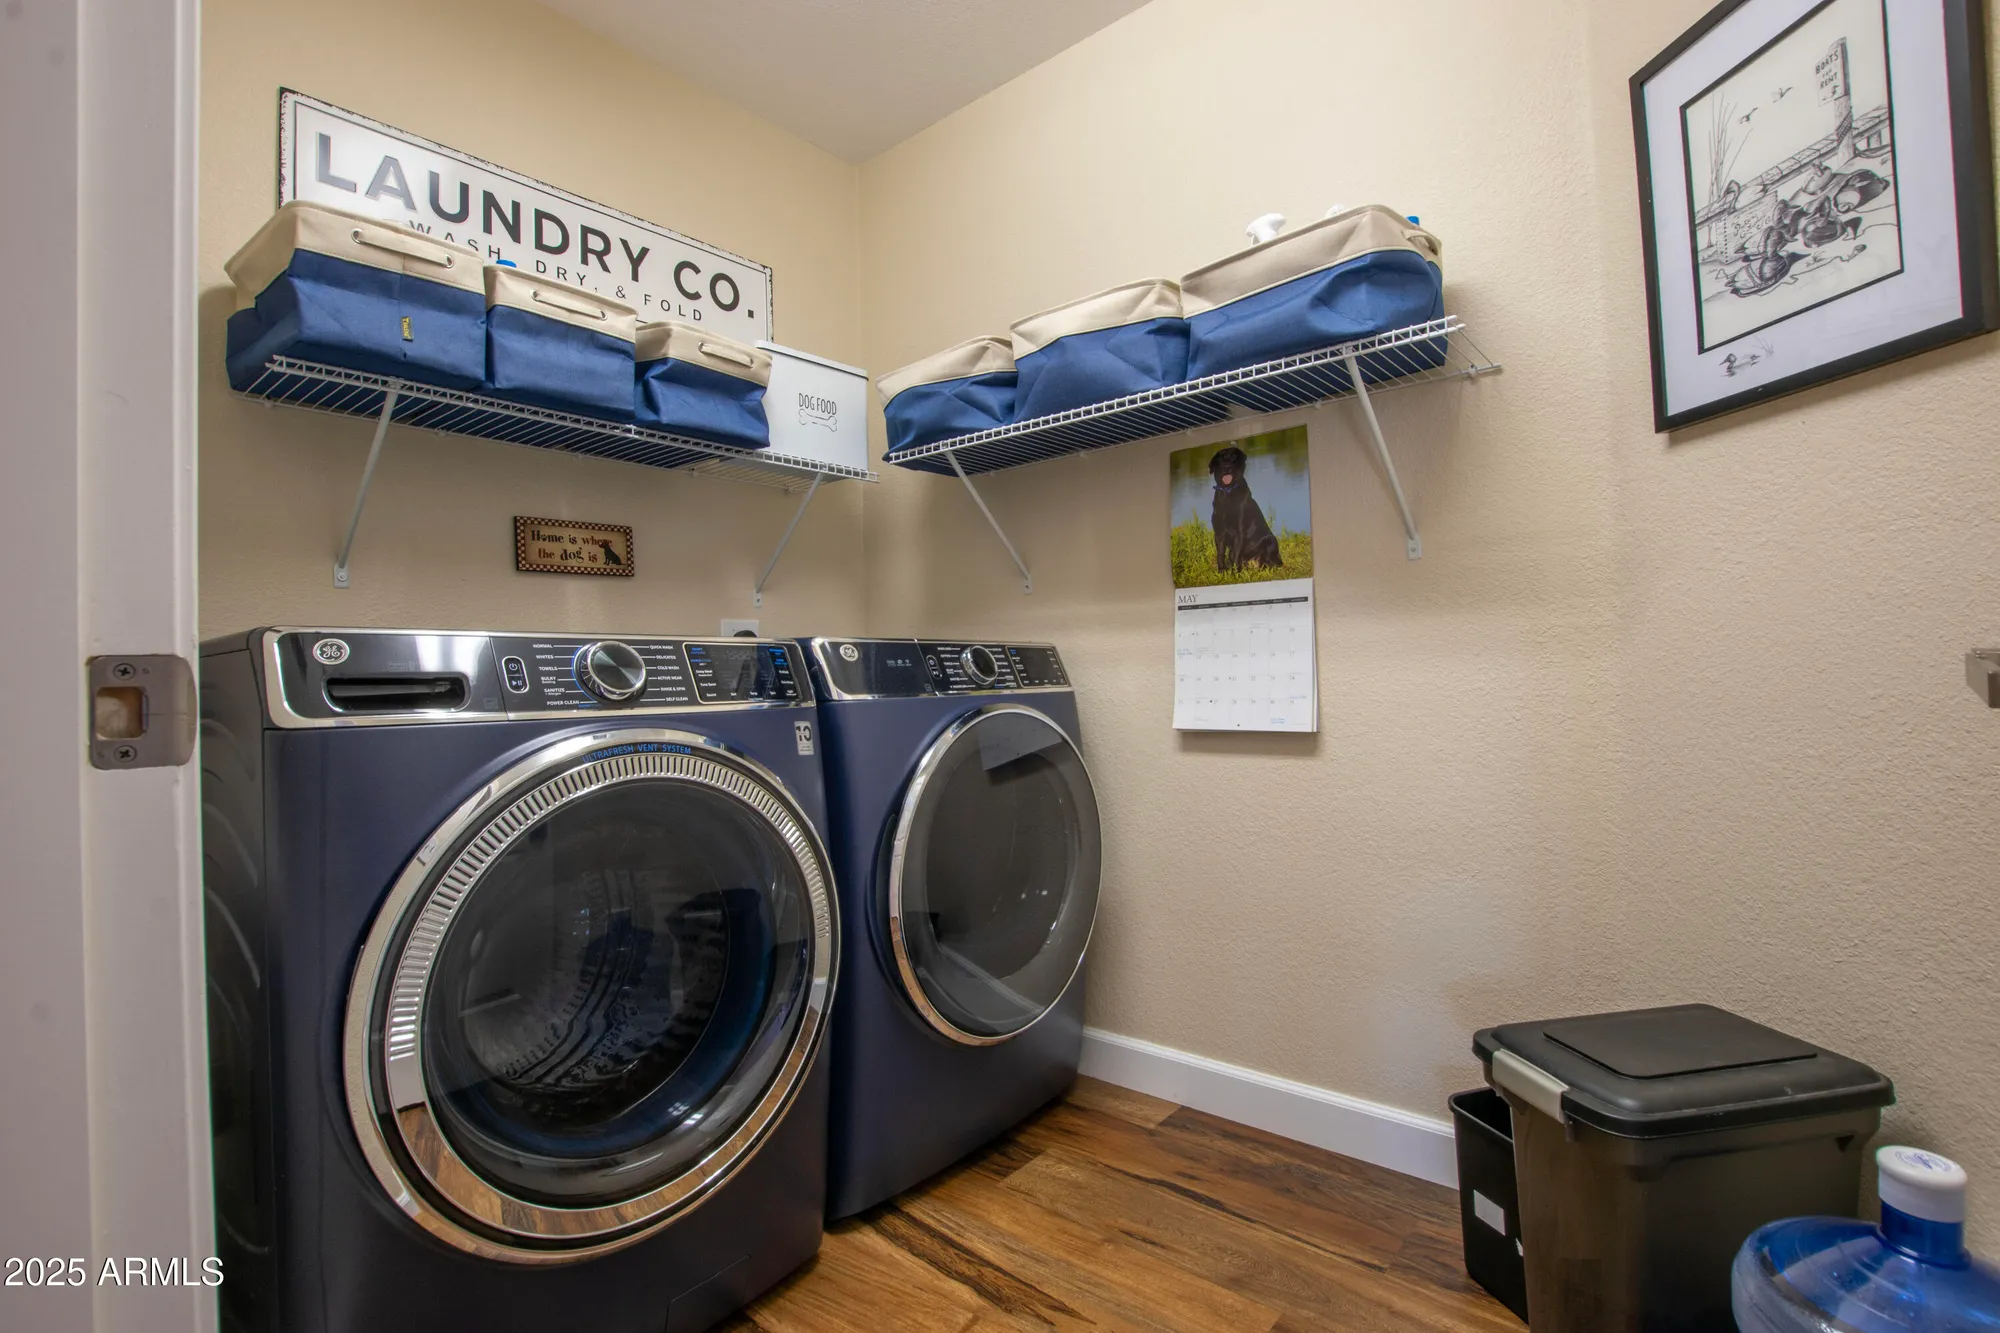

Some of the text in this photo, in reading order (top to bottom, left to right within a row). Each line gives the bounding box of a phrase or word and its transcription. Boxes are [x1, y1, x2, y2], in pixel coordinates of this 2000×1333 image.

[1815, 50, 1839, 75] BOATS
[315, 132, 754, 319] LAUNDRY CO.
[615, 285, 627, 299] &
[643, 293, 702, 321] FOLD
[798, 392, 837, 415] DOG FOOD
[568, 534, 577, 545] is
[538, 546, 598, 563] the dog is
[1178, 595, 1197, 604] MAY
[582, 743, 692, 763] ULTRAFRESH VENT SYSTEM
